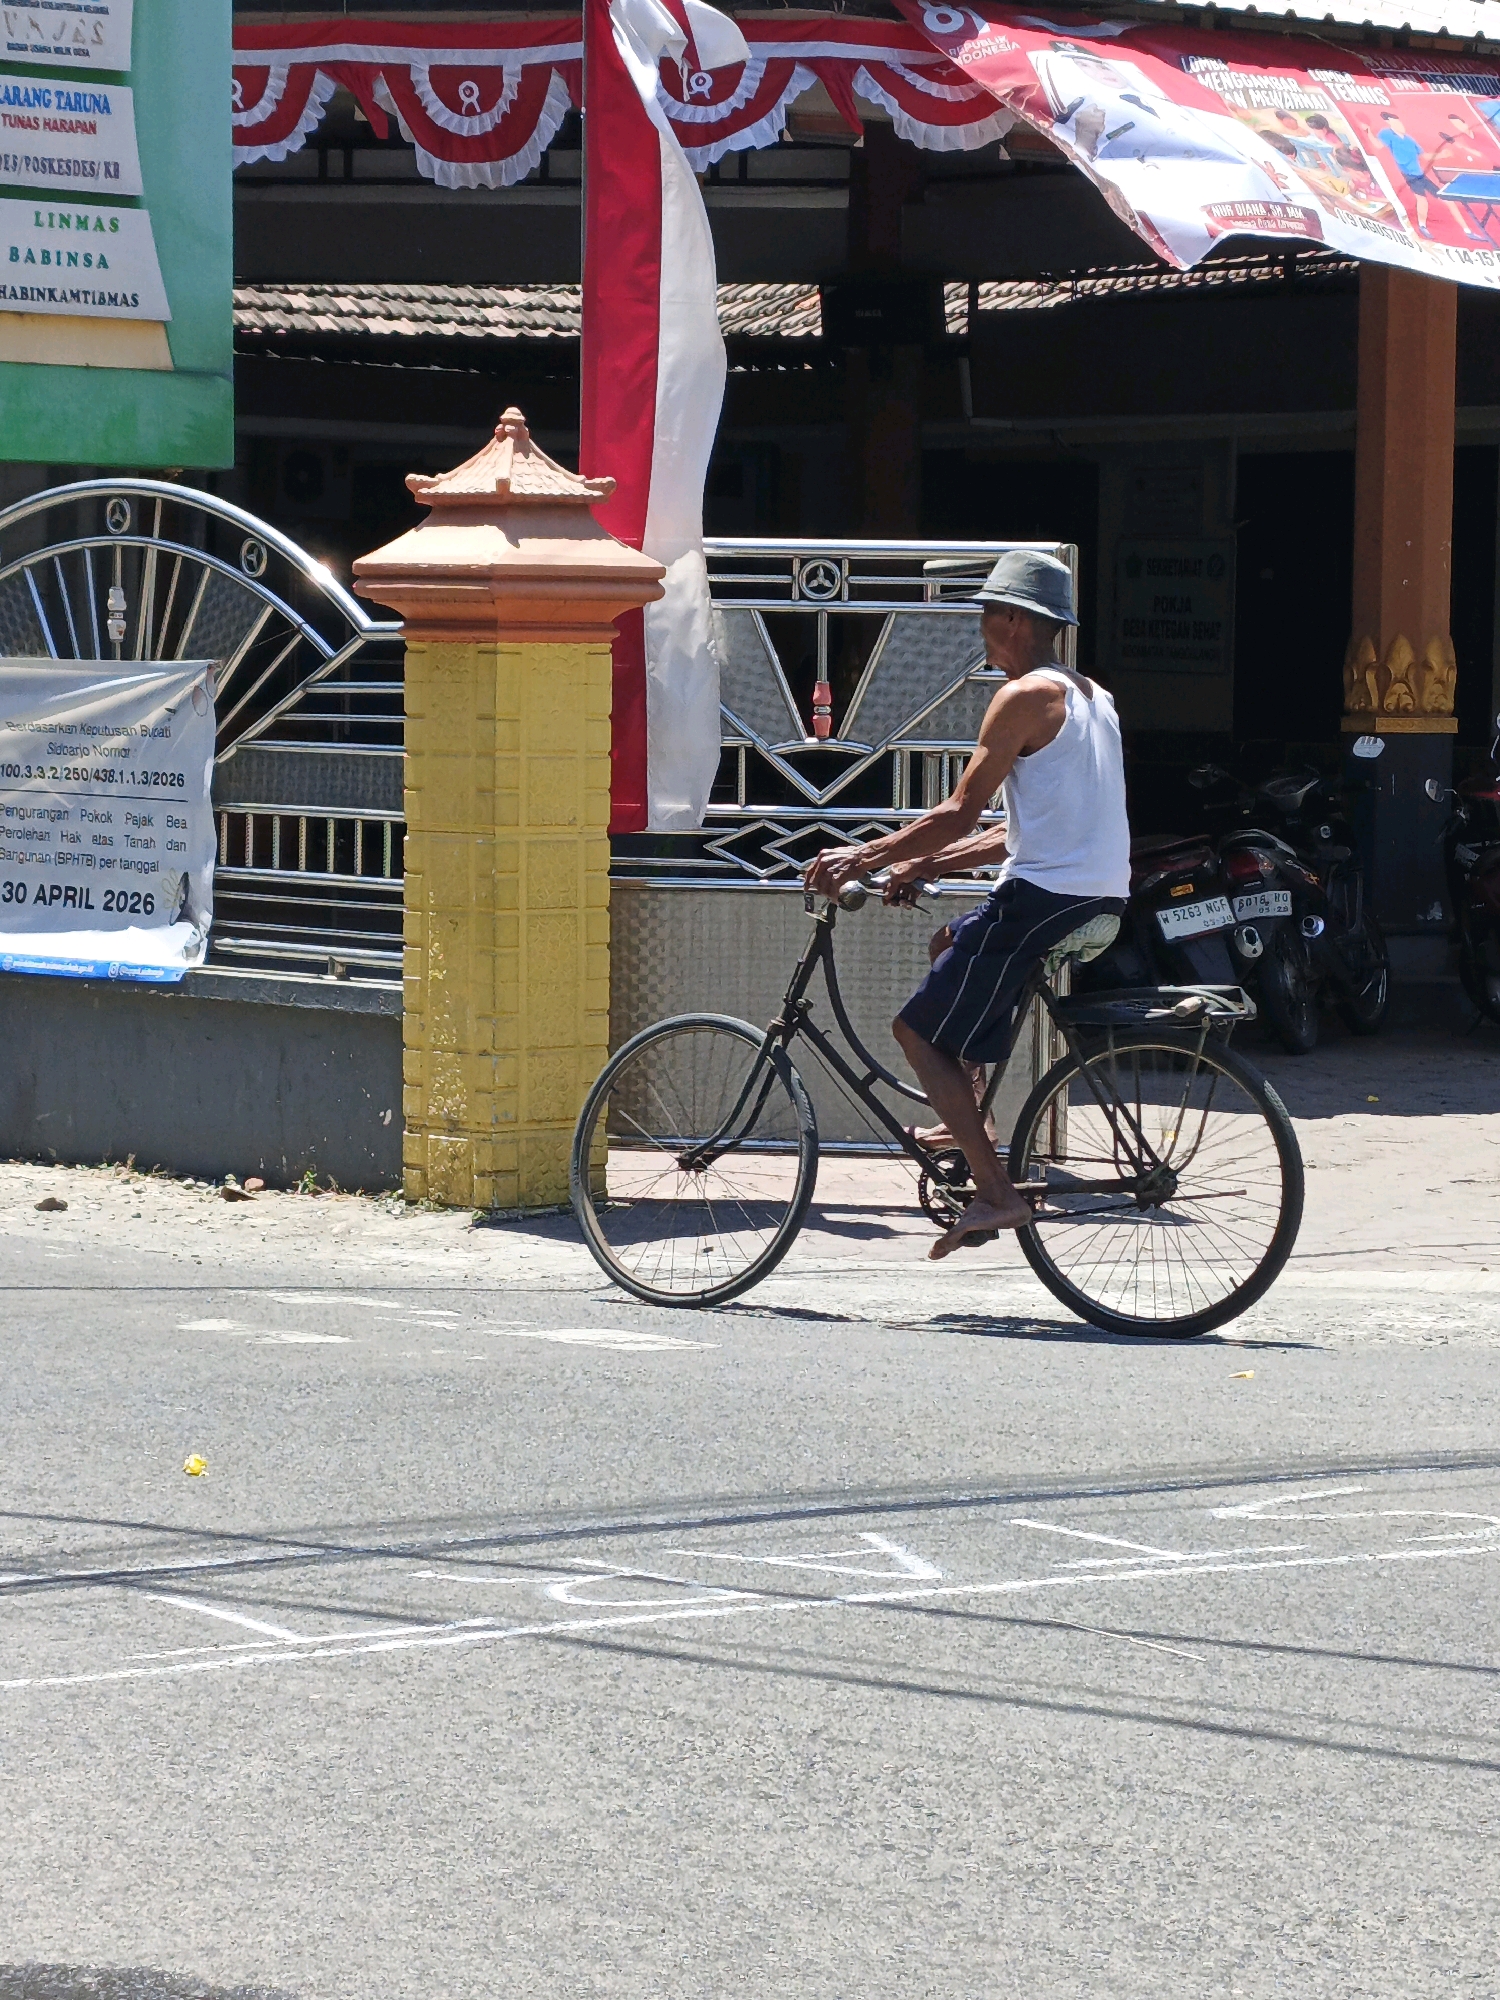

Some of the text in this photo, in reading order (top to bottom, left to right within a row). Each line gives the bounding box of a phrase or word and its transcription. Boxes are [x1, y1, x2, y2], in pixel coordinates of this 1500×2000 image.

[953, 41, 1021, 66] NDONESIA
[1180, 55, 1229, 74] LOMBA
[1197, 71, 1302, 94] MENGGAMBAR
[1307, 68, 1355, 84] LOMBA
[54, 89, 112, 115] TARUNA
[1248, 89, 1328, 110] MEWARNAI
[1324, 81, 1391, 106] TENNIS
[1, 112, 98, 135] TUNAS HARAPAN
[34, 210, 120, 233] LINMAS
[1211, 203, 1234, 218] NUR
[9, 246, 109, 269] BABINSA
[80, 722, 138, 739] Keputusan
[80, 808, 113, 824] Pokok
[125, 811, 154, 829] Pajak
[166, 814, 188, 829] Bea
[60, 830, 82, 844] Hak
[123, 834, 157, 850] Tanah
[166, 838, 187, 852] dan
[99, 857, 118, 869] per
[119, 858, 160, 875] tanggal
[1, 880, 155, 916] 30 APRIL 2026
[1160, 912, 1170, 925] W
